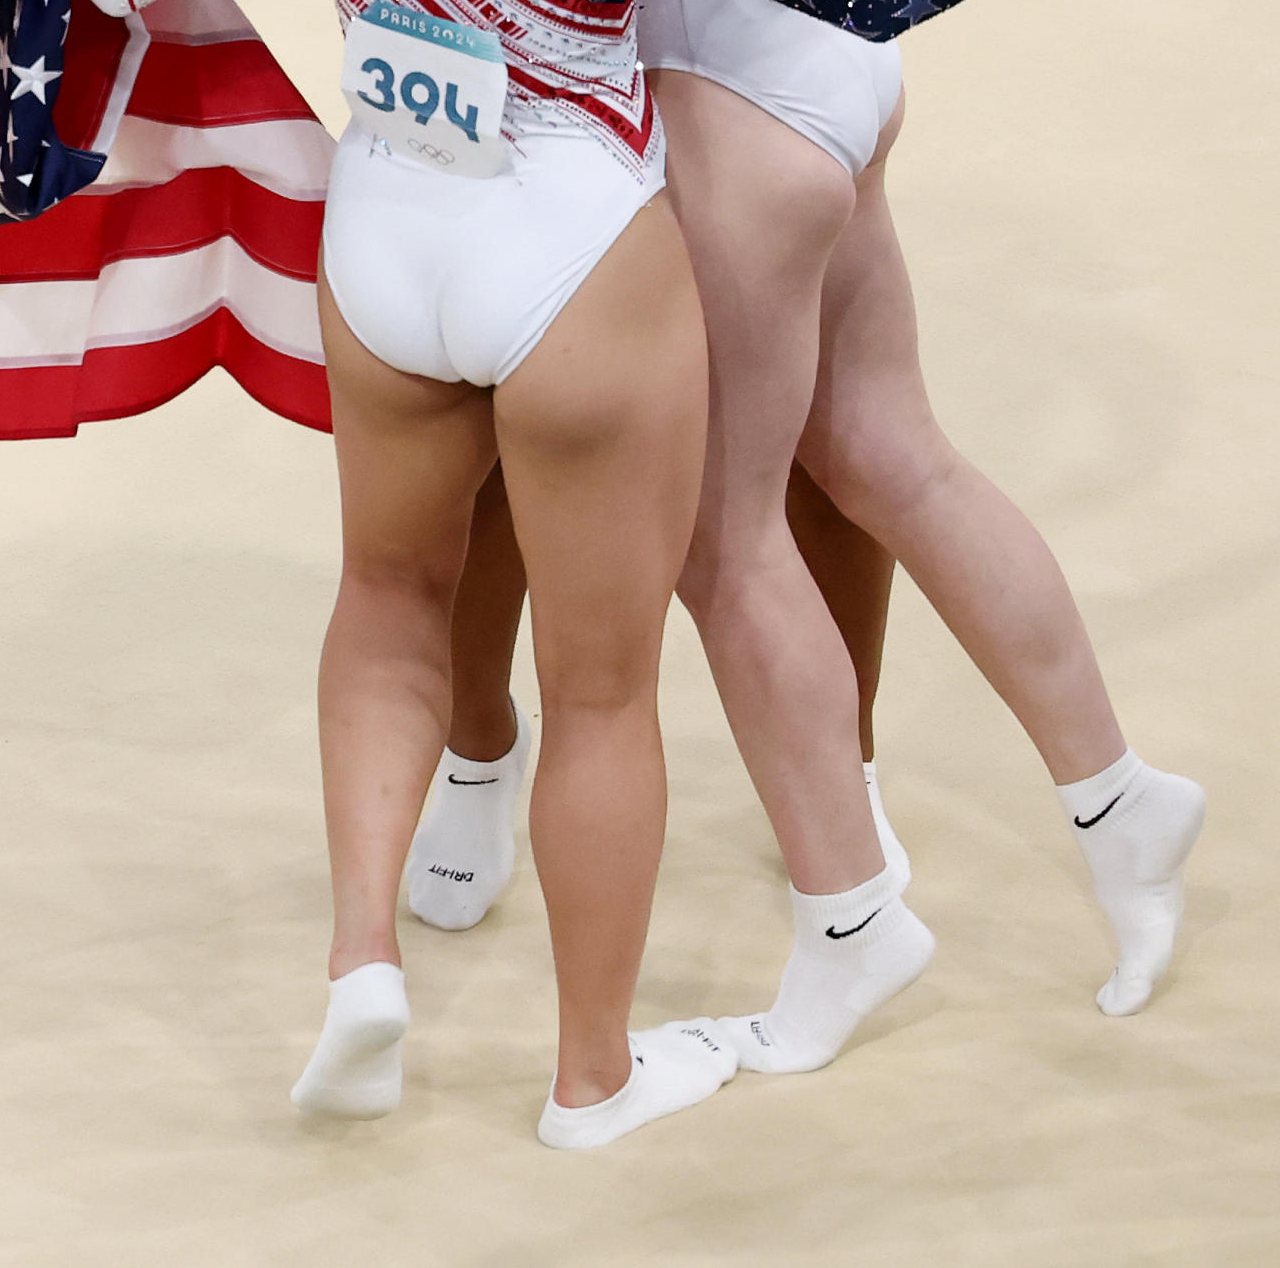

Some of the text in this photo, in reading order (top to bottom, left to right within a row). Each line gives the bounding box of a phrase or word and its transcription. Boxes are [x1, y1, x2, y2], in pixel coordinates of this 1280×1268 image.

[380, 8, 475, 48] PARIS 2024
[357, 58, 480, 144] 394
[427, 864, 474, 882] DRI-FIT
